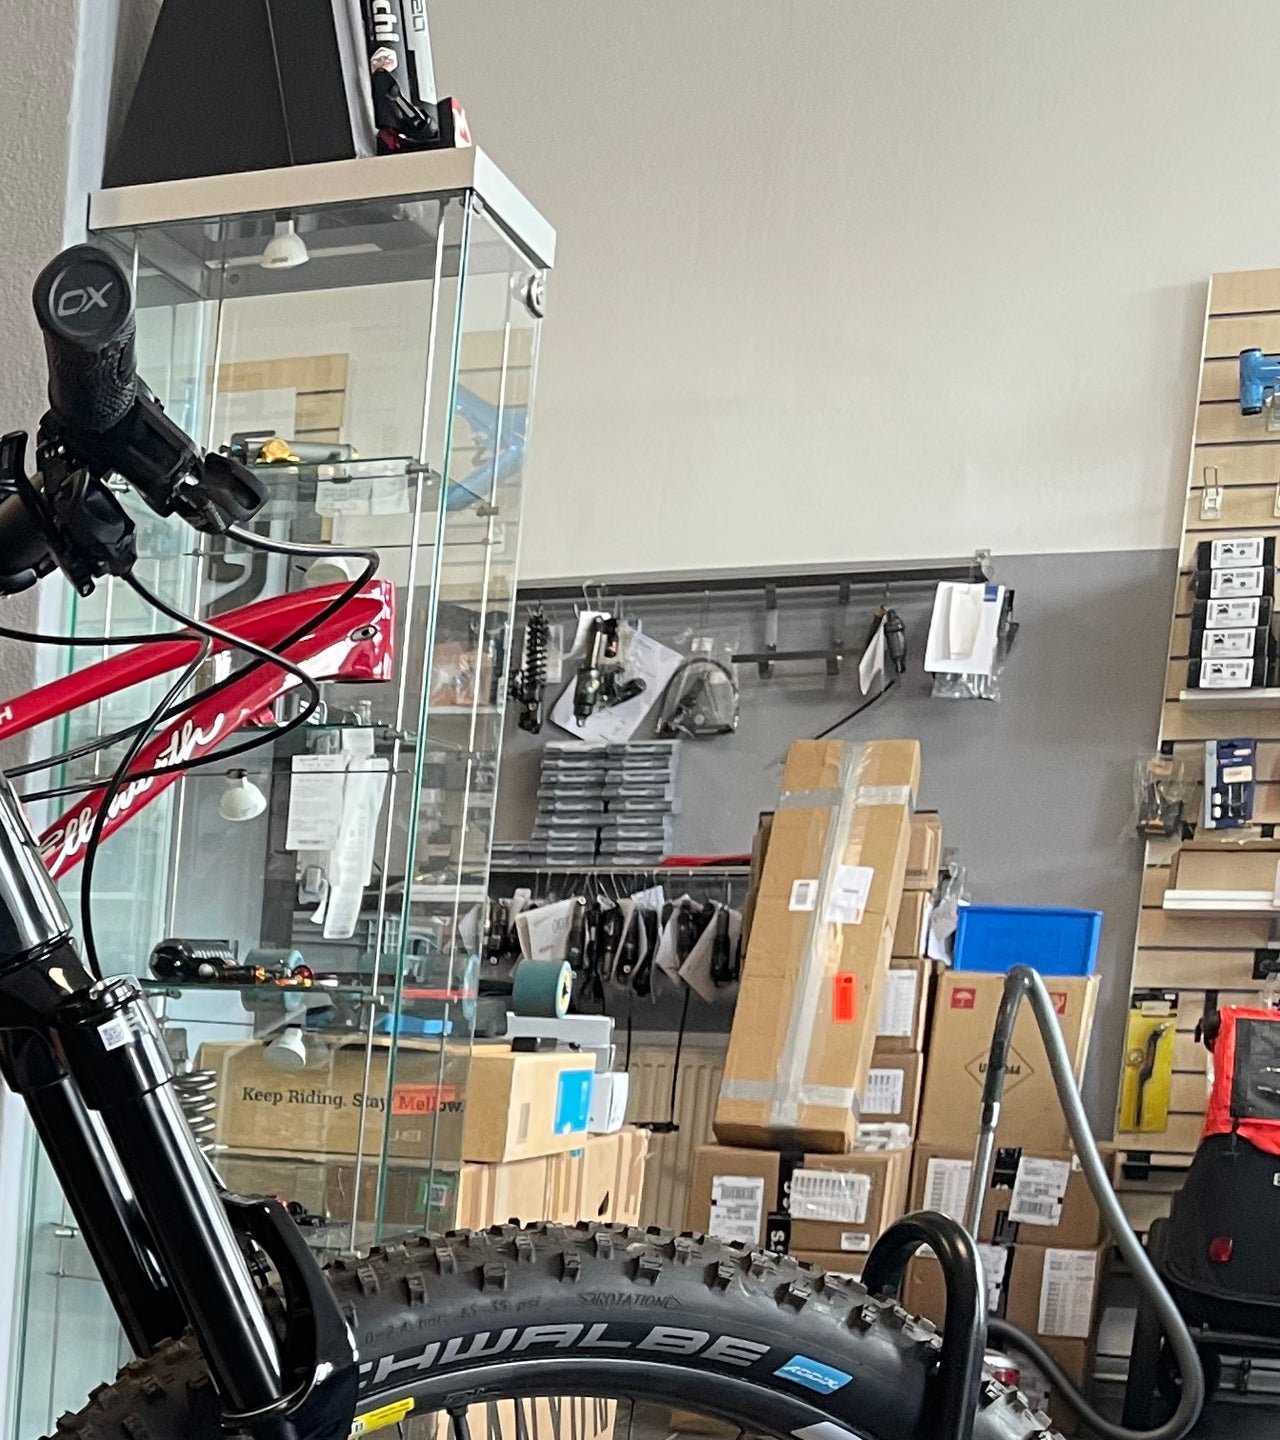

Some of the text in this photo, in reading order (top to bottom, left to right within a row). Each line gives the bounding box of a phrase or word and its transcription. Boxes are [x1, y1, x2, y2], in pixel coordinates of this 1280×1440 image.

[242, 1086, 283, 1106] Keep
[288, 1088, 347, 1109] Riding.
[397, 1094, 466, 1114] Mellow.
